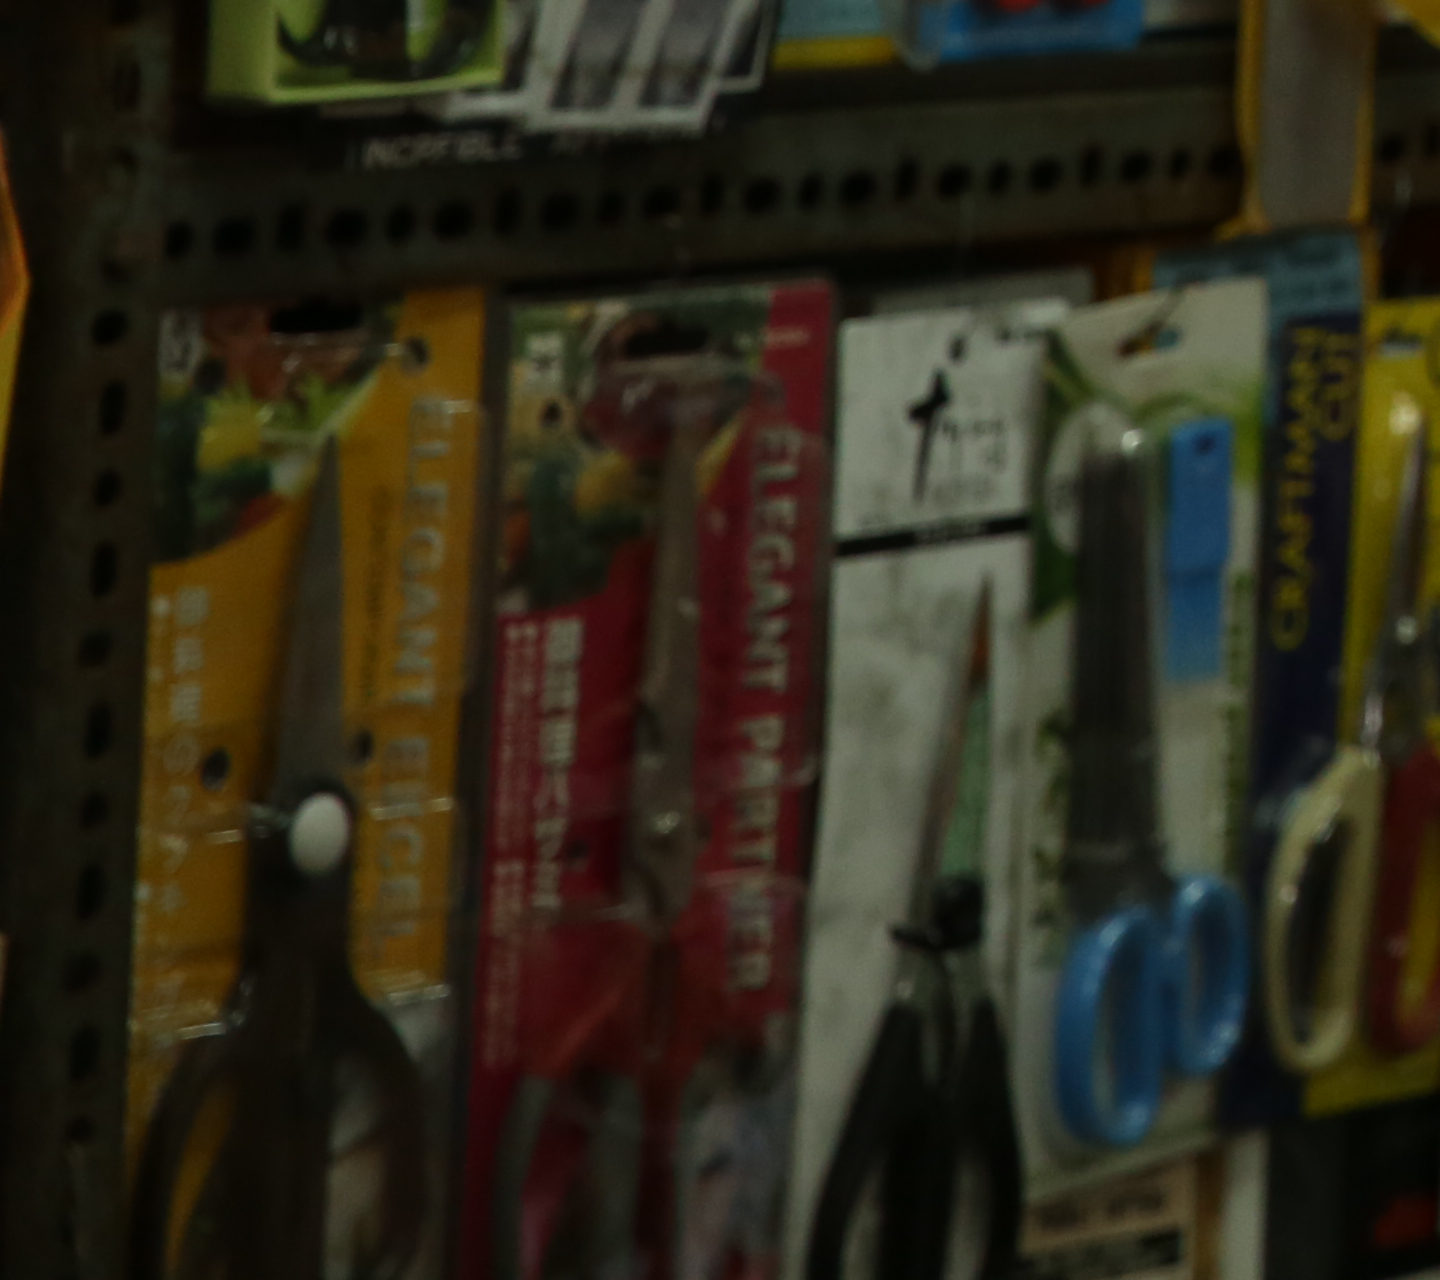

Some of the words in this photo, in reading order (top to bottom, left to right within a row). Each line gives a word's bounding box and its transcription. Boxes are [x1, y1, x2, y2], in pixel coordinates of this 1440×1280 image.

[1269, 326, 1322, 653] CRAFTMAN
[1318, 329, 1359, 441] CUT
[396, 397, 457, 707] ELEGANT
[740, 426, 803, 692] ELEGANT
[727, 718, 785, 992] PARTNER
